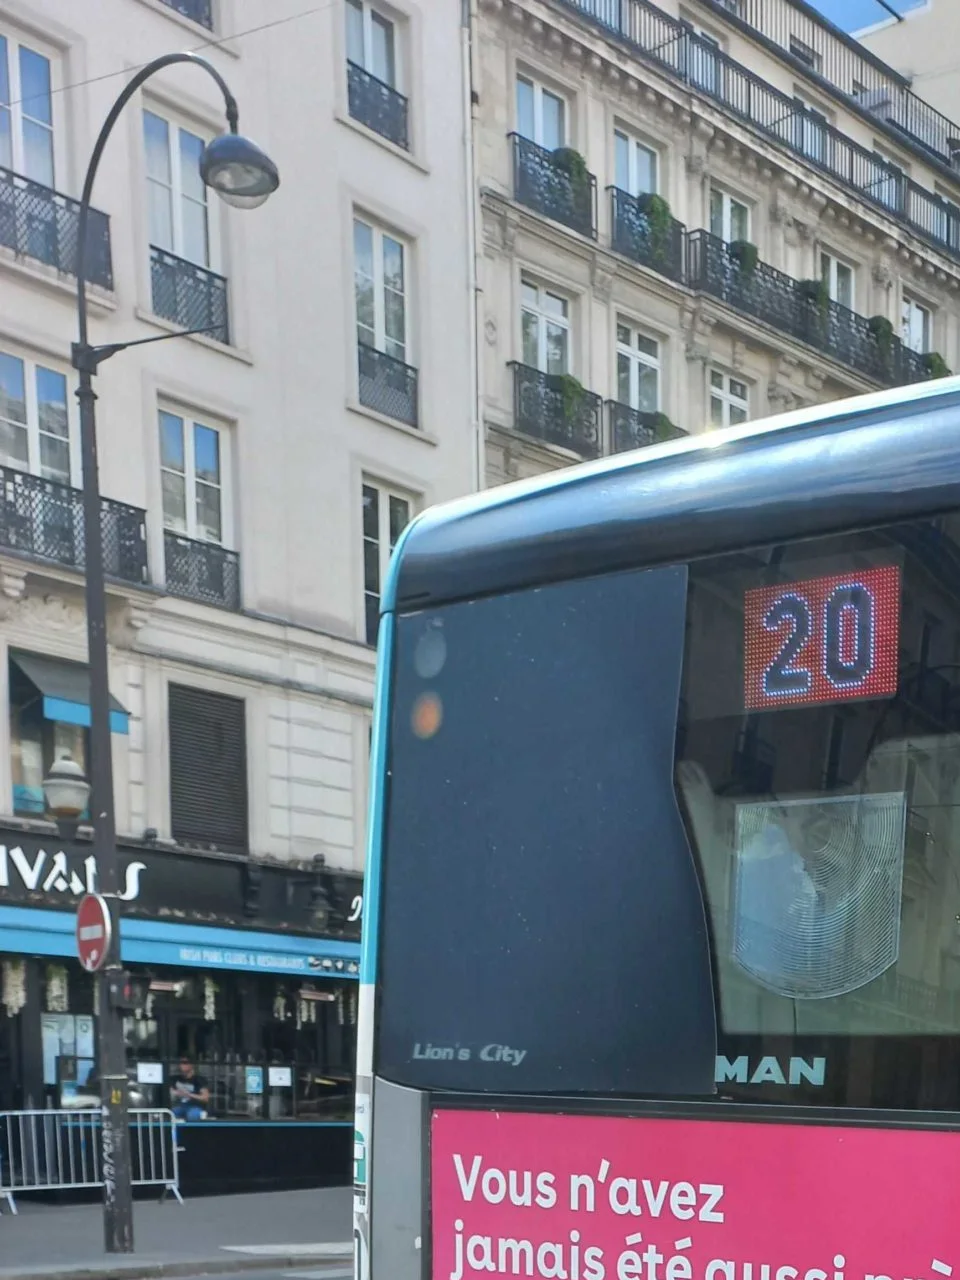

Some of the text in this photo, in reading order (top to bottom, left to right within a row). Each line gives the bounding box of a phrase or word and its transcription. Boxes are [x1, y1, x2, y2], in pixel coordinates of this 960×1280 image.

[762, 582, 876, 698] 20
[412, 1043, 527, 1066] Lion's City
[714, 1055, 826, 1085] MAN
[452, 1154, 724, 1223] Vous n'avez
